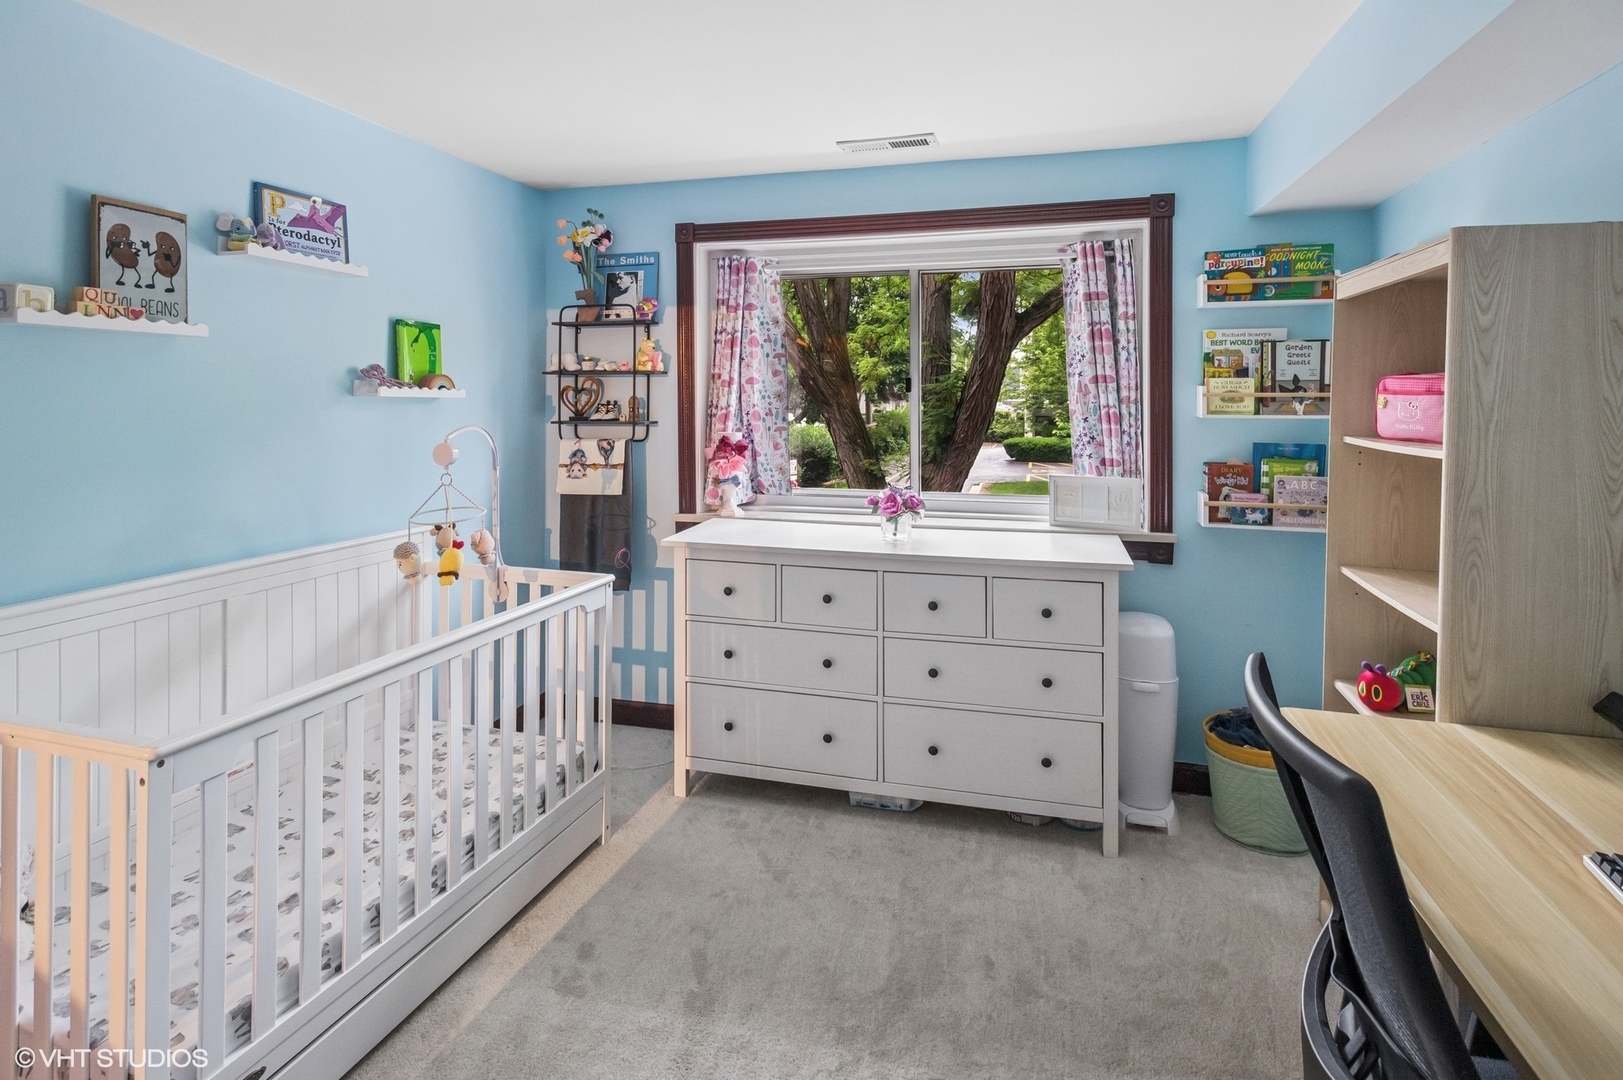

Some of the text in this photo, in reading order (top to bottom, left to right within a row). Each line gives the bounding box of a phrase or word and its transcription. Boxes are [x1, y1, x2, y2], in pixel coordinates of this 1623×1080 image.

[269, 192, 286, 217] P
[598, 255, 655, 265] The Smiths
[1264, 249, 1320, 262] GOODNIGHT
[1295, 260, 1327, 270] MOON
[141, 298, 180, 318] BEANS
[1280, 517, 1326, 525] HALLOWEEN
[1410, 693, 1428, 701] ERIC
